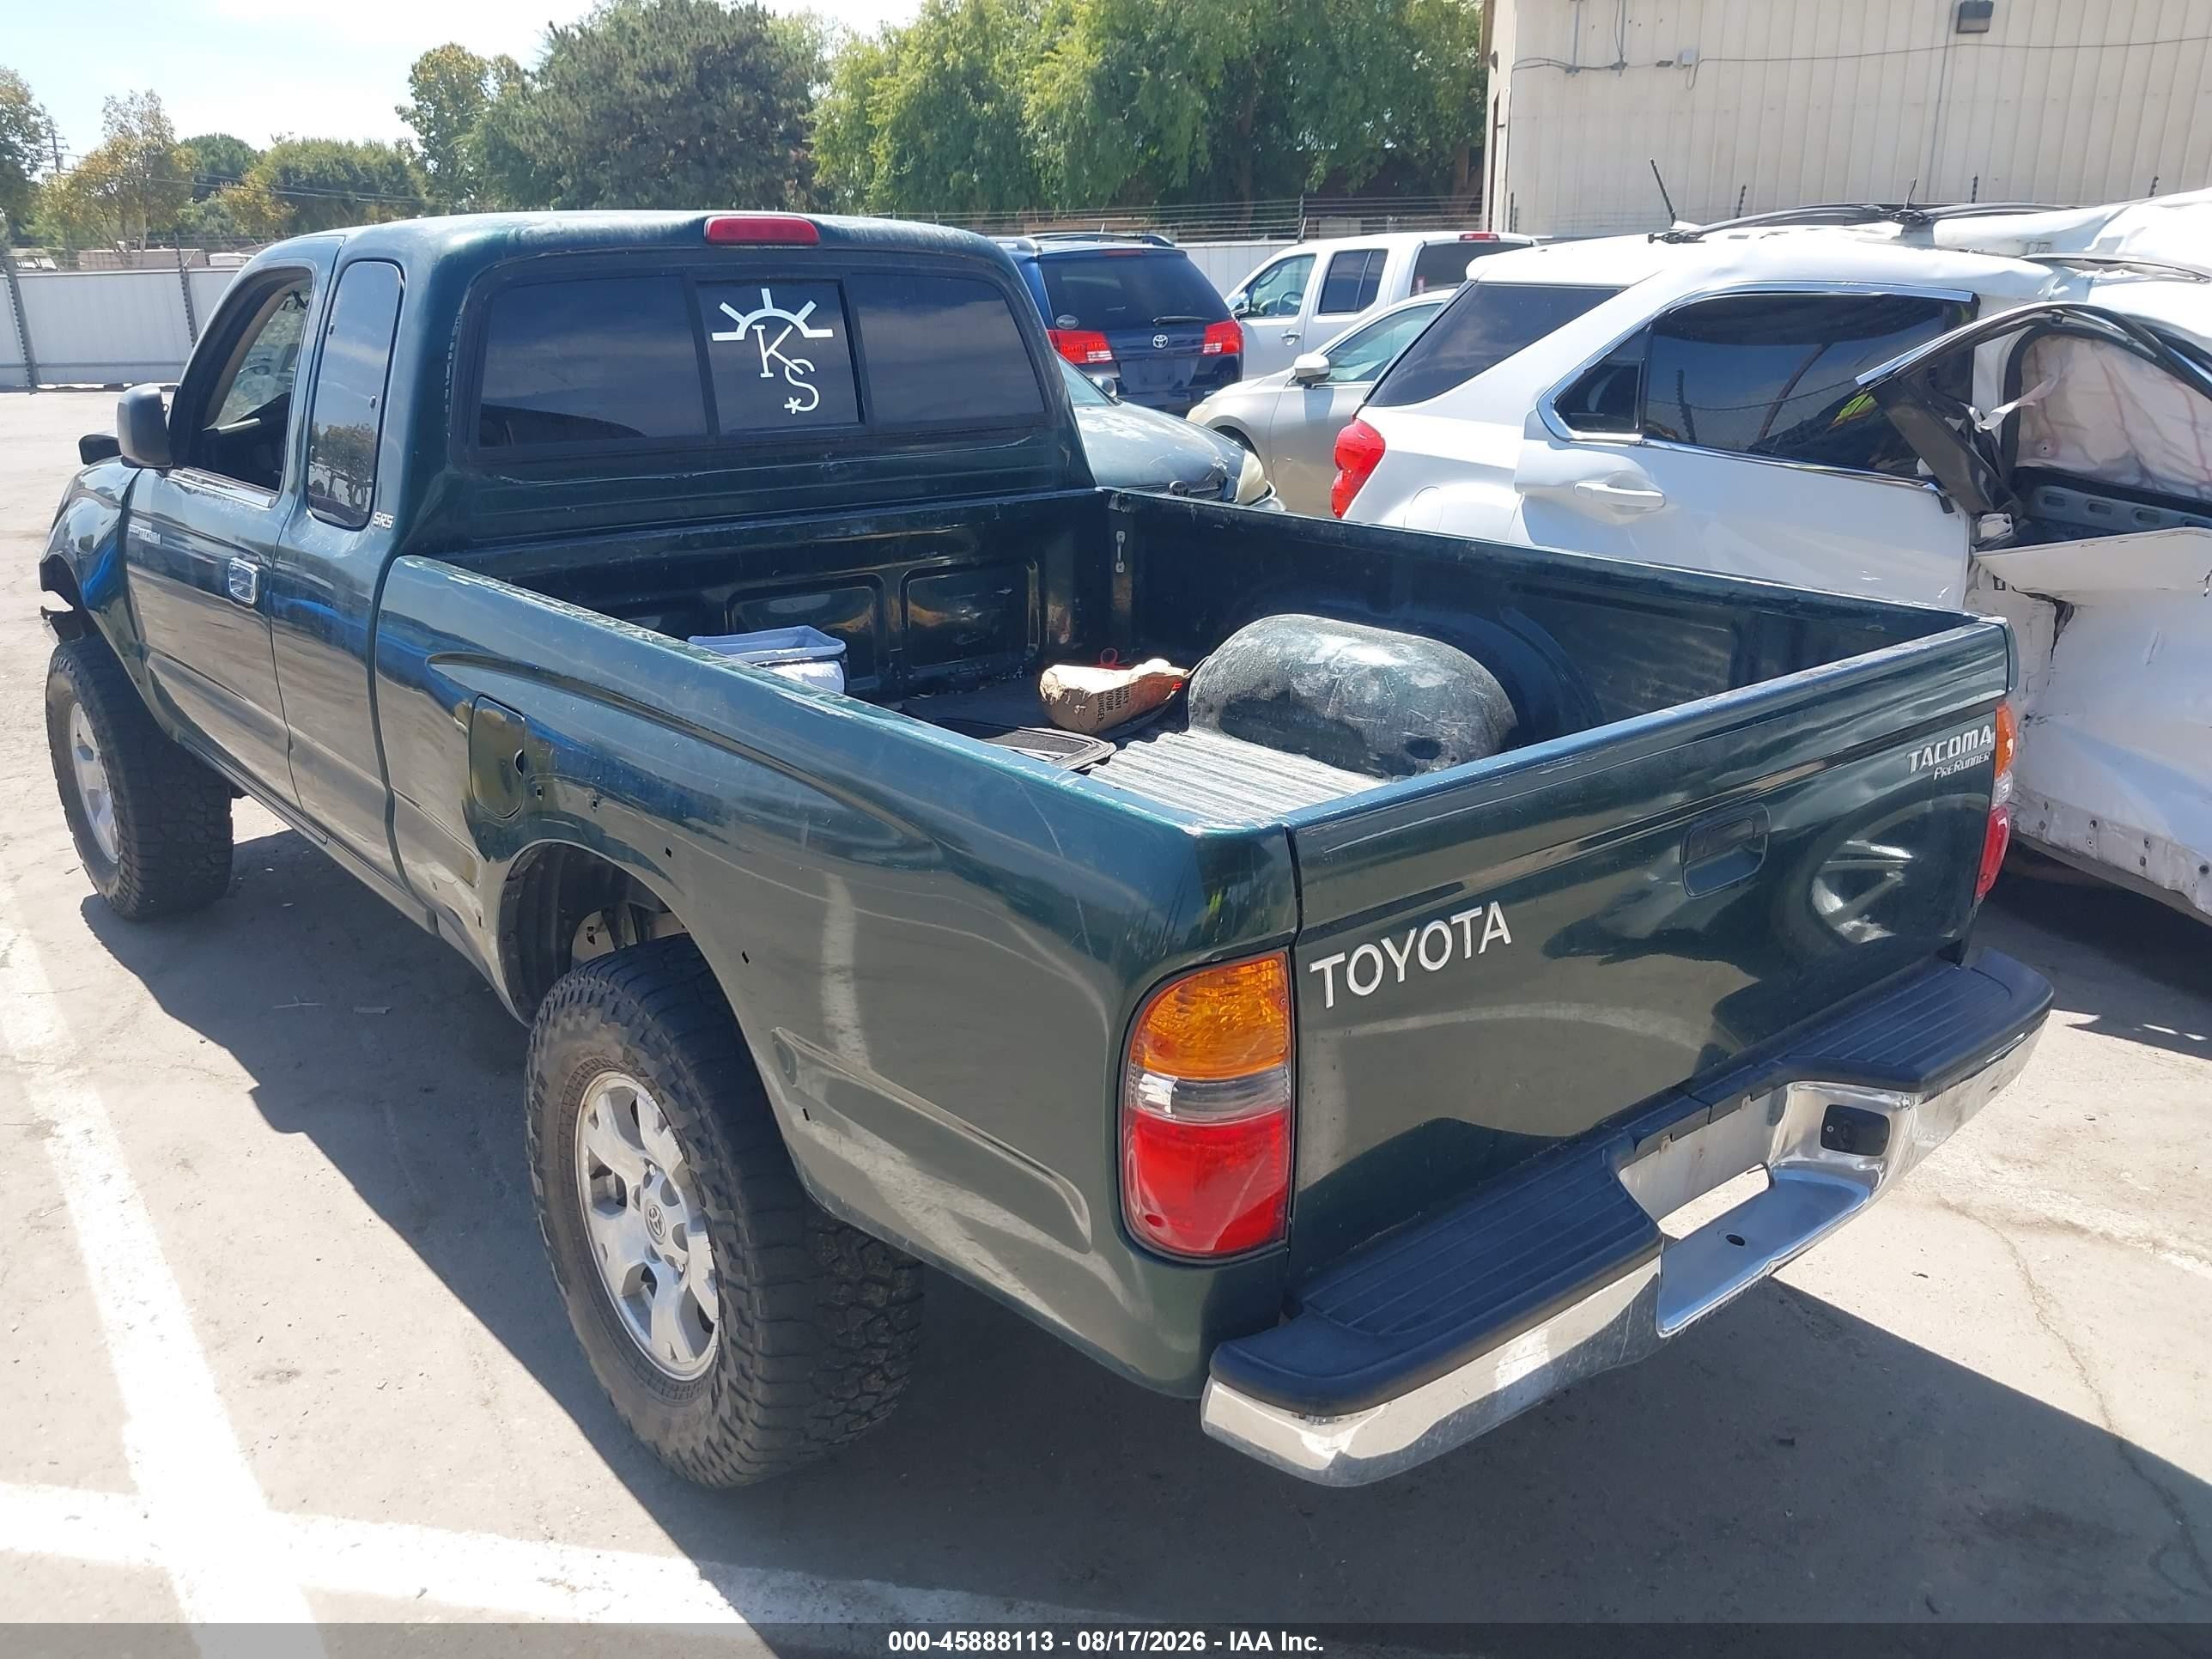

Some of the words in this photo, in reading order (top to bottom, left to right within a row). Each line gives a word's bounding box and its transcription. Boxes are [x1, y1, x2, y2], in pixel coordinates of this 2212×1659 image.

[1106, 690, 1115, 711] YOUR
[1907, 725, 1992, 775] TACOMA
[1309, 901, 1512, 1009] TOYOTA
